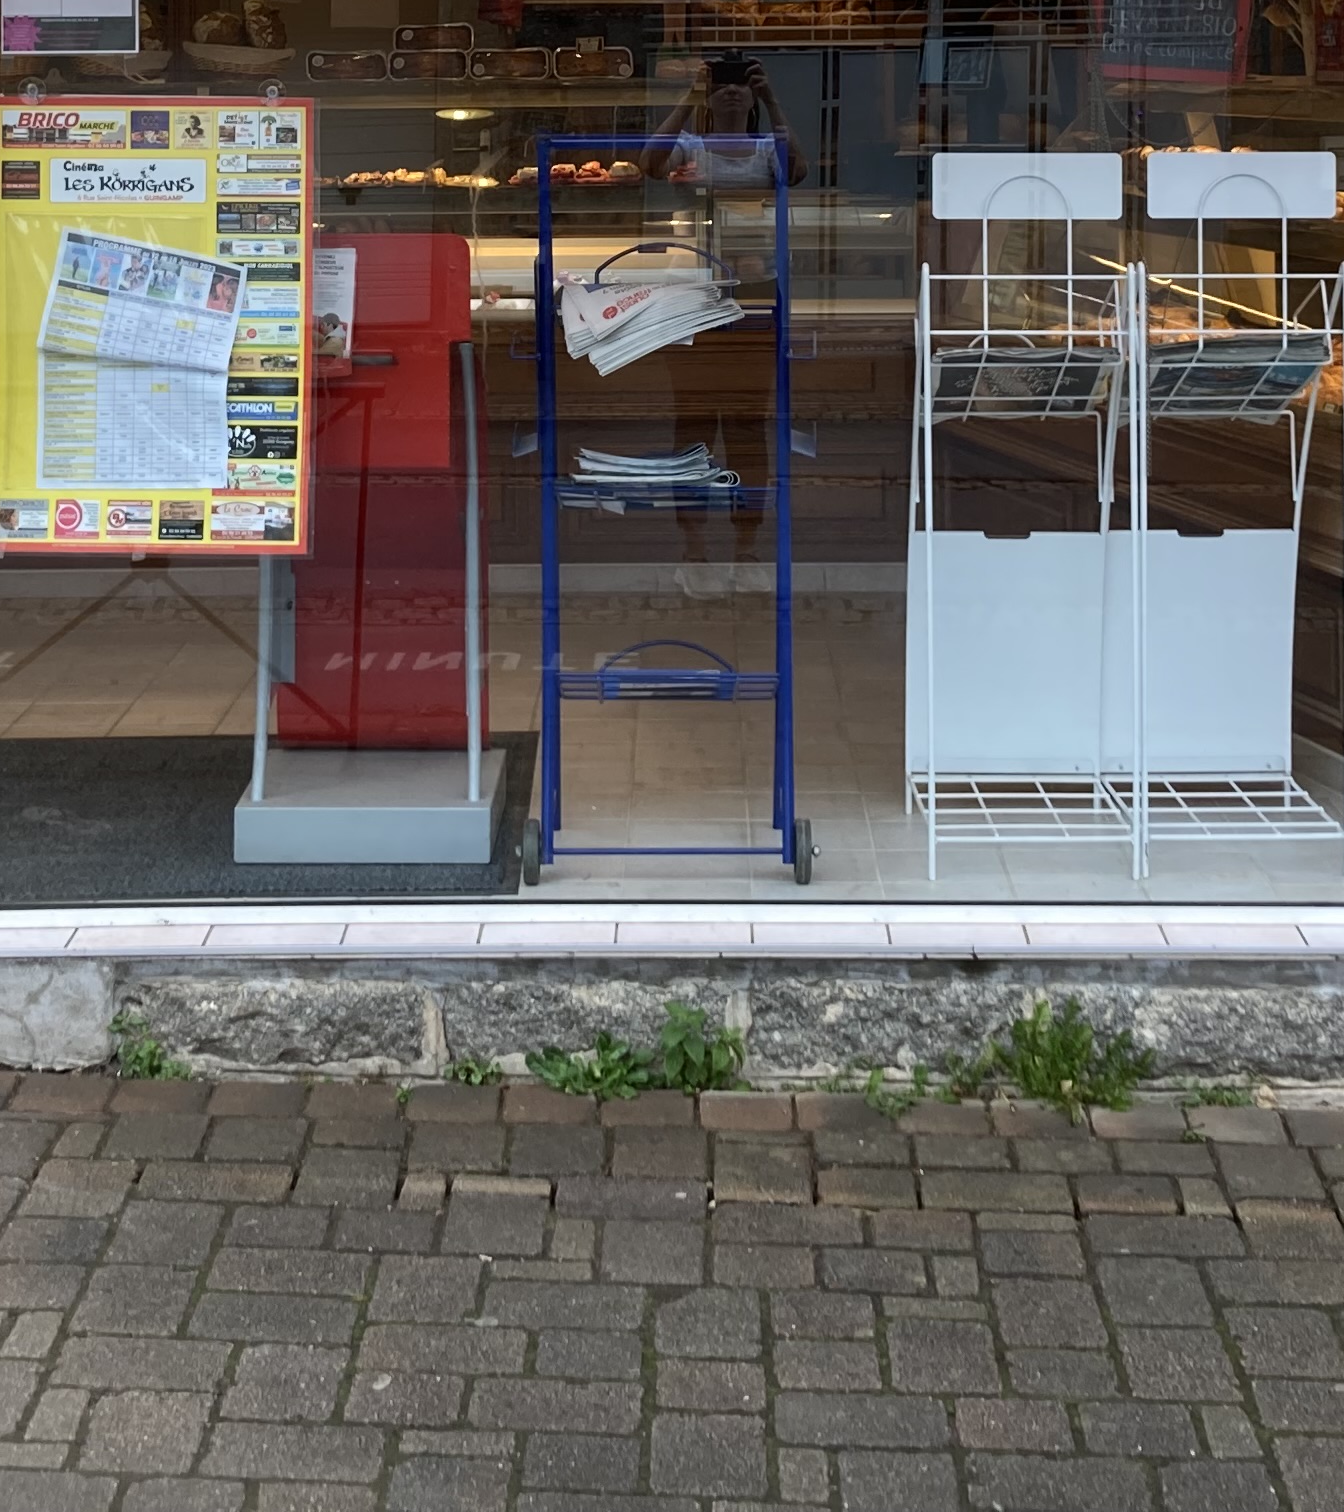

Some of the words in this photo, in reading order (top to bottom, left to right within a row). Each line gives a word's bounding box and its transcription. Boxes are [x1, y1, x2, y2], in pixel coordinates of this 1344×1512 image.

[18, 112, 80, 128] BRICO
[80, 121, 115, 130] MARCHÉ
[63, 160, 104, 172] Cinéma
[93, 239, 142, 257] PROGRAMME
